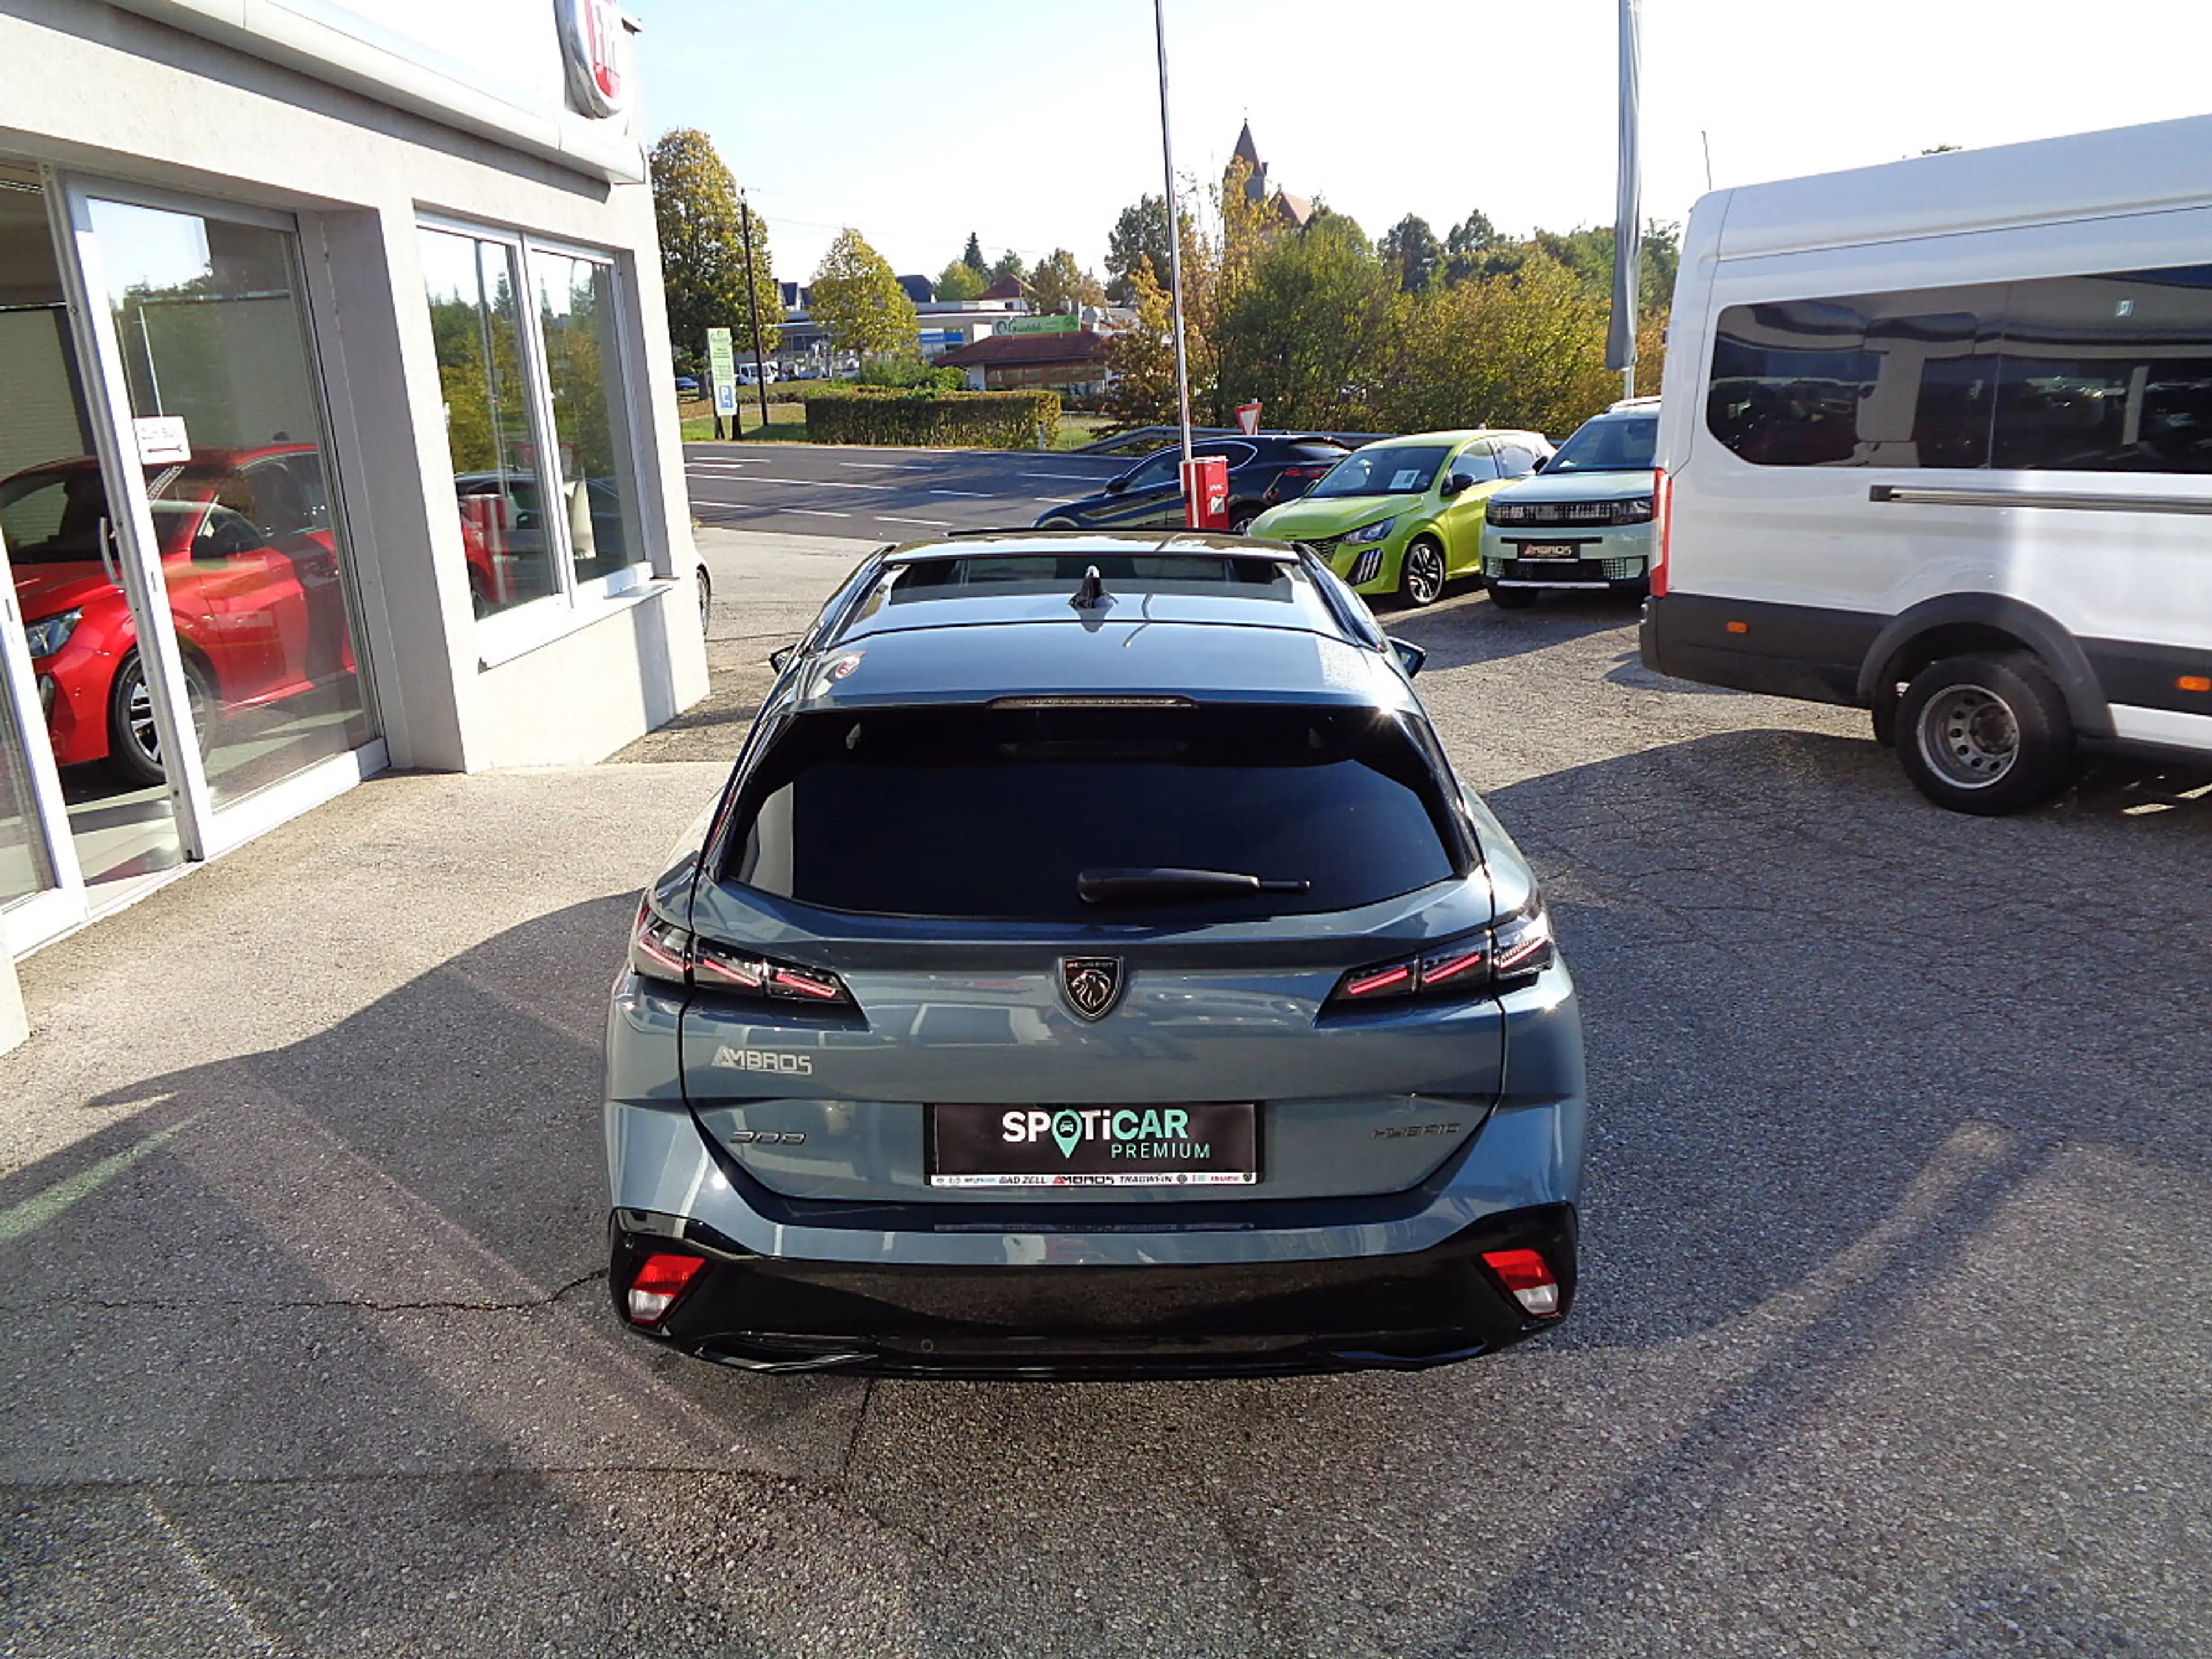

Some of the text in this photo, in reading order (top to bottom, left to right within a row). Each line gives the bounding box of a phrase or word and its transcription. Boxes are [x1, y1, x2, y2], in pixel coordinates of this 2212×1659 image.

[711, 1044, 812, 1075] AMBROS
[730, 1130, 806, 1145] 308
[1111, 1143, 1210, 1158] PREMIUM
